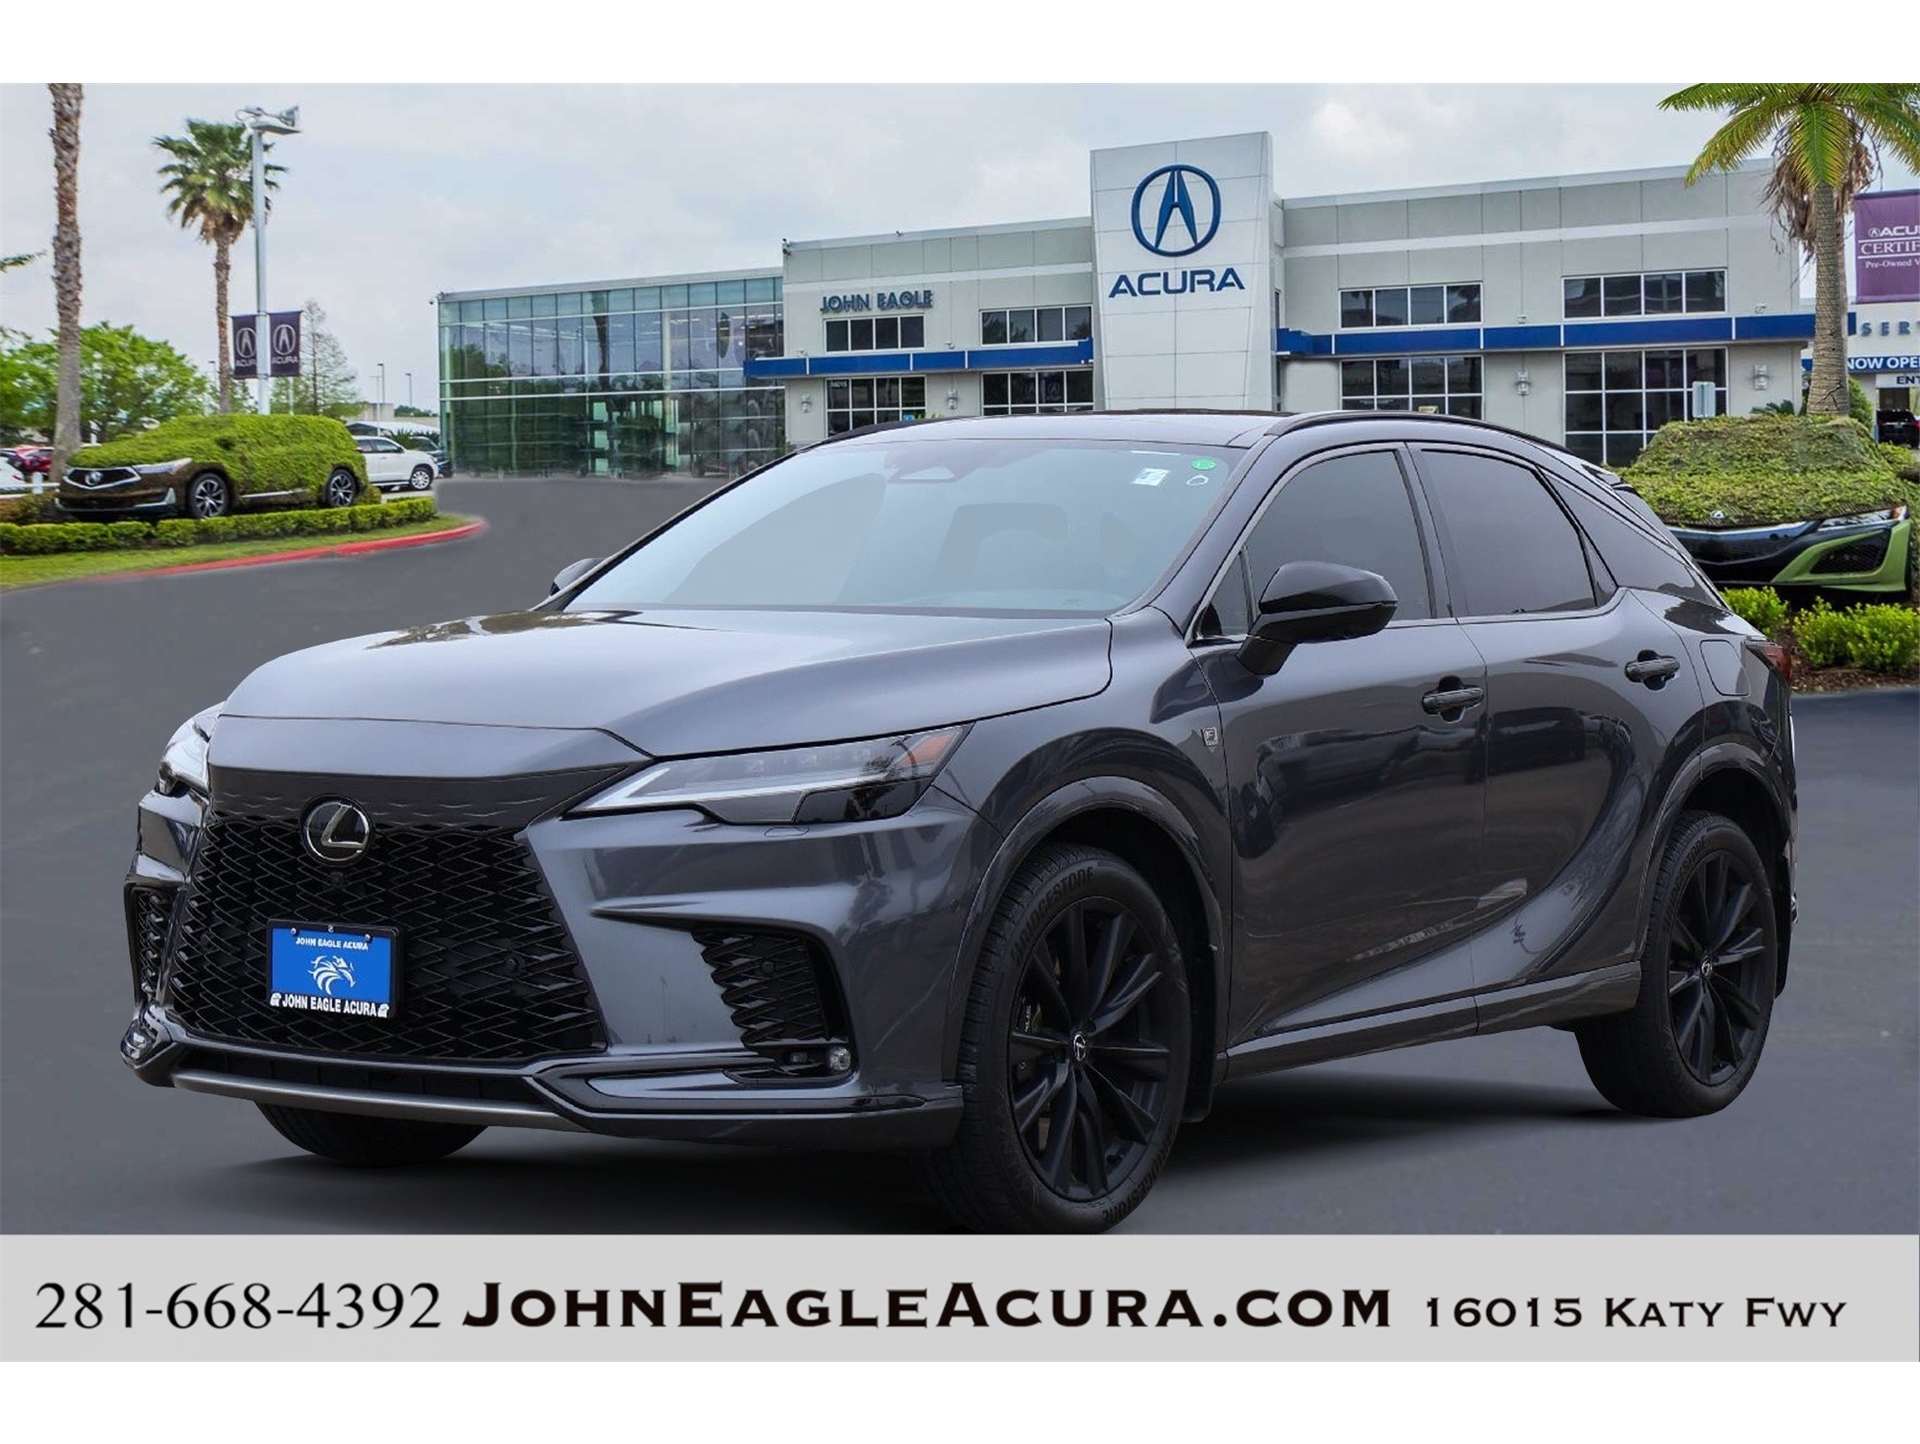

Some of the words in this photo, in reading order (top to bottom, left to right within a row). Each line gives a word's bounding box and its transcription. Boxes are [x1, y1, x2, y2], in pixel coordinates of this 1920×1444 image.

[1880, 225, 1920, 237] ACU
[1865, 259, 1912, 269] Pre-Owned
[1109, 266, 1246, 298] ACURA
[820, 293, 871, 313] JOHN
[877, 290, 933, 310] EAGLE
[1861, 320, 1920, 337] SER
[1886, 357, 1920, 369] OPE
[296, 937, 316, 946] JOHN
[318, 938, 341, 948] EAGLE
[343, 941, 368, 950] ACURA
[282, 994, 308, 1009] JOHN
[310, 997, 341, 1013] EAGLE
[344, 1001, 376, 1017] ACURA
